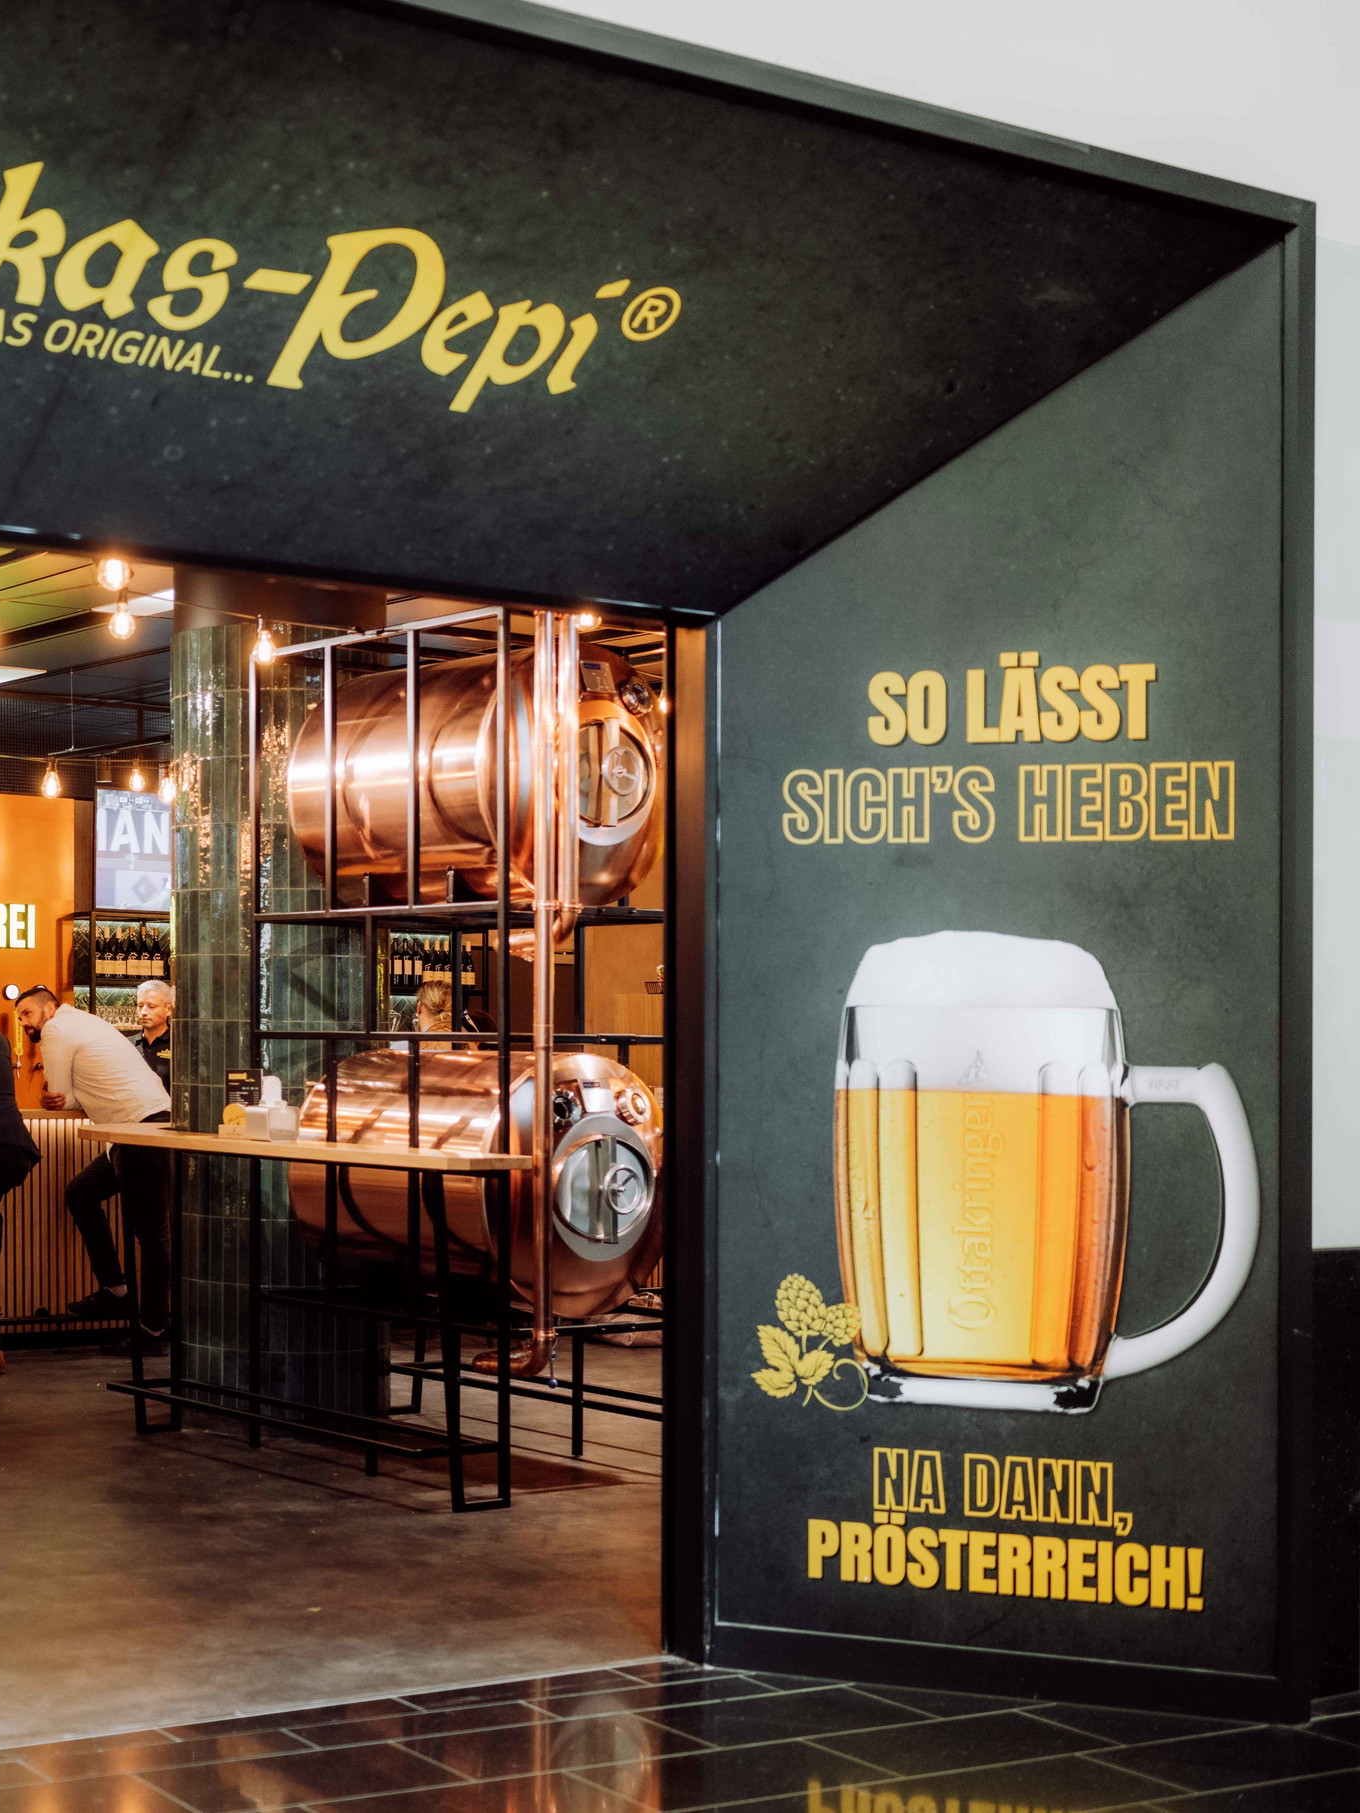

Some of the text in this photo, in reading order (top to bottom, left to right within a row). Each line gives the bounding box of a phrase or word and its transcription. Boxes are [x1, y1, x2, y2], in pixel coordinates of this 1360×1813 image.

[42, 316, 253, 384] ORIGINAL...
[867, 651, 1157, 746] SO LÄSST
[1018, 760, 1236, 842] HEBEN
[872, 1446, 1133, 1536] NA DANN,
[807, 1510, 1204, 1613] PRÖSTERREICH!
